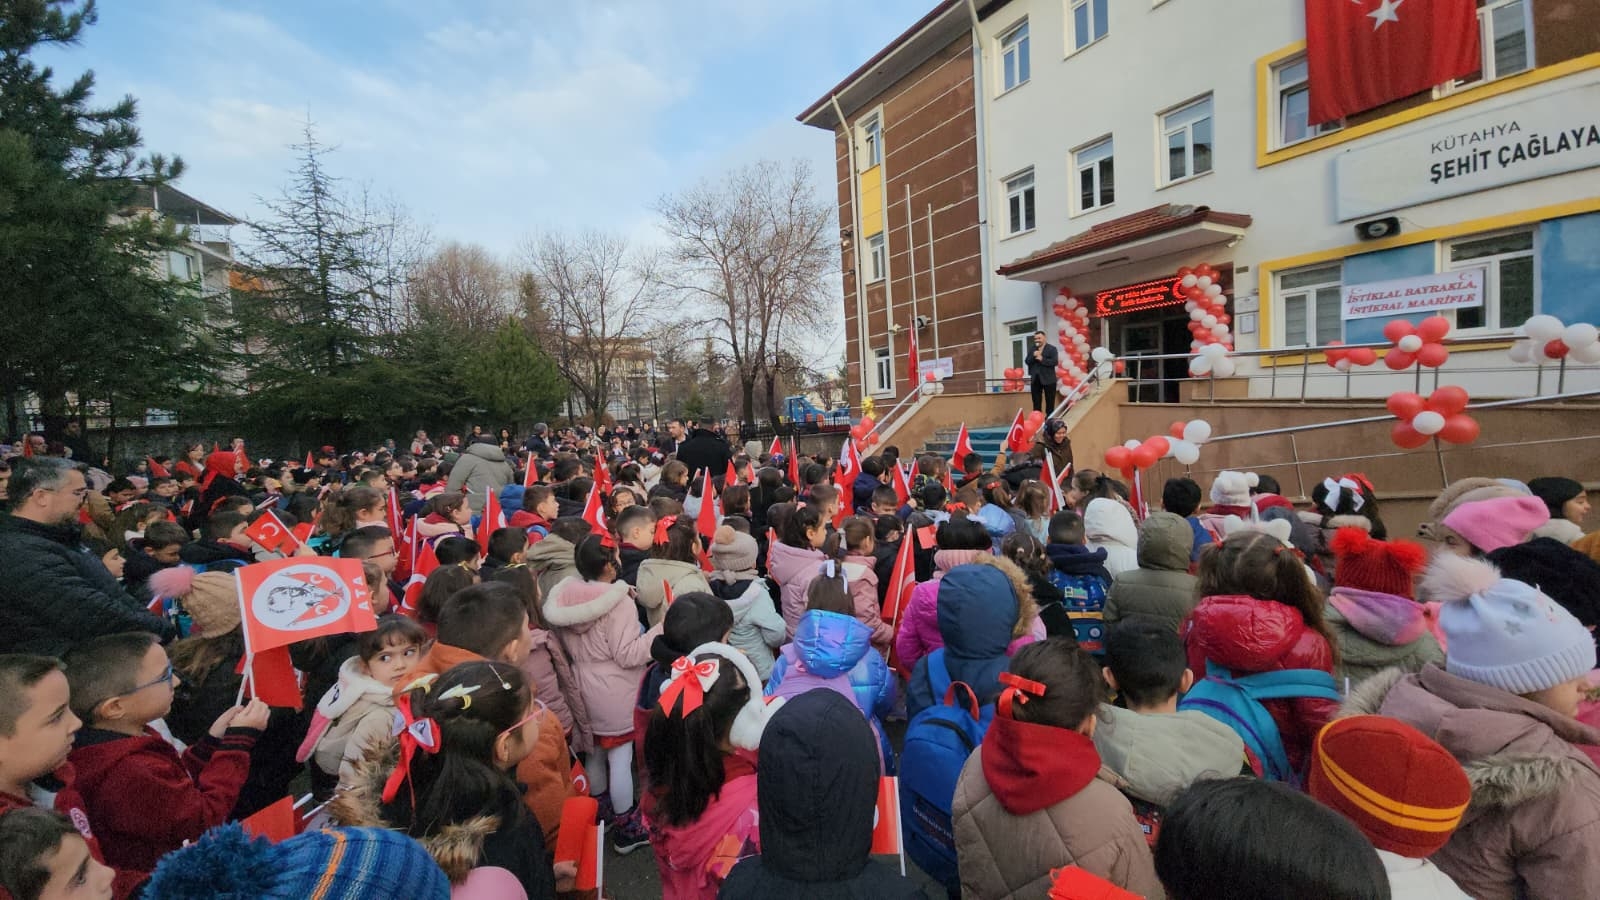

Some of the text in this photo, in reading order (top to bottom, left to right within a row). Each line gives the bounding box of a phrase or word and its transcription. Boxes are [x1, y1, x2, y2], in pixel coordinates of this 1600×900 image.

[1430, 124, 1600, 184] ŞEHİT ÇAĞLAYA
[1431, 120, 1521, 154] KÜTAHYA
[1347, 290, 1402, 304] İSTİKLAL
[1349, 293, 1475, 315] İSTİKBAL MAARİFLE
[353, 576, 370, 611] ATA
